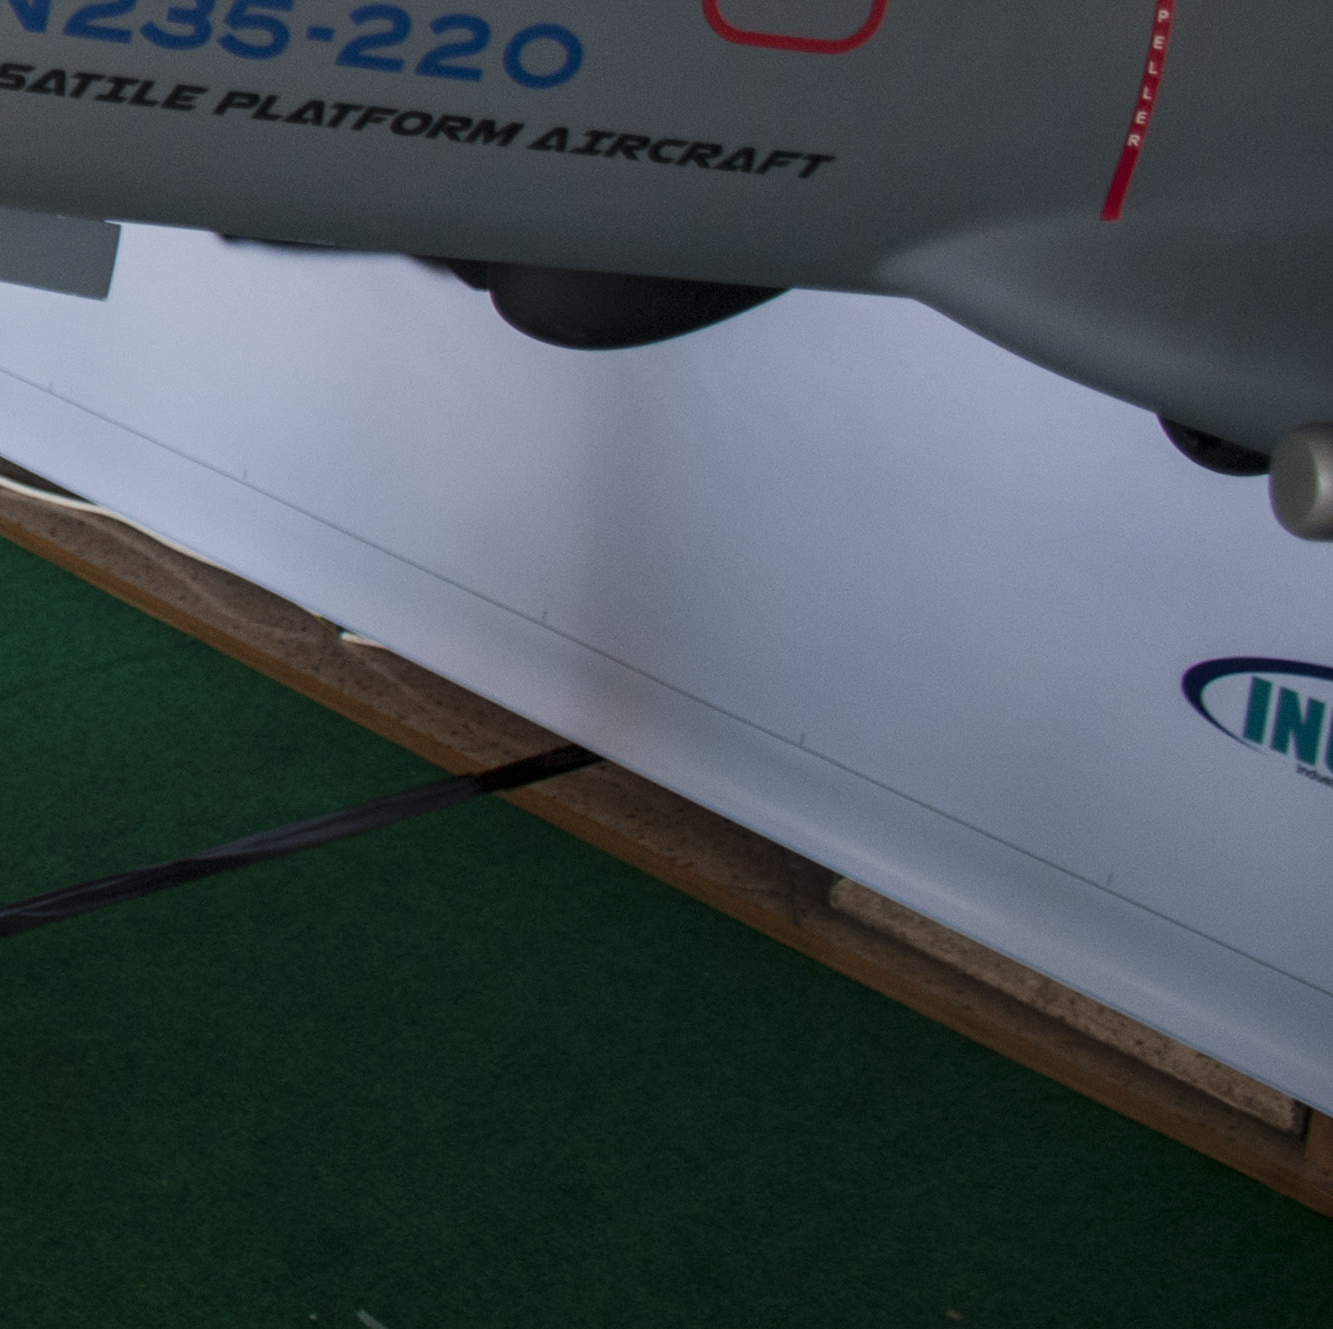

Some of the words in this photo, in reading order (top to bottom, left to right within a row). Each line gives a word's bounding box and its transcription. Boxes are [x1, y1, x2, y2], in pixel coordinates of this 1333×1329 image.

[211, 88, 527, 152] PLATFORM
[526, 120, 839, 182] AIRCRAFT
[1242, 674, 1333, 773] IN
